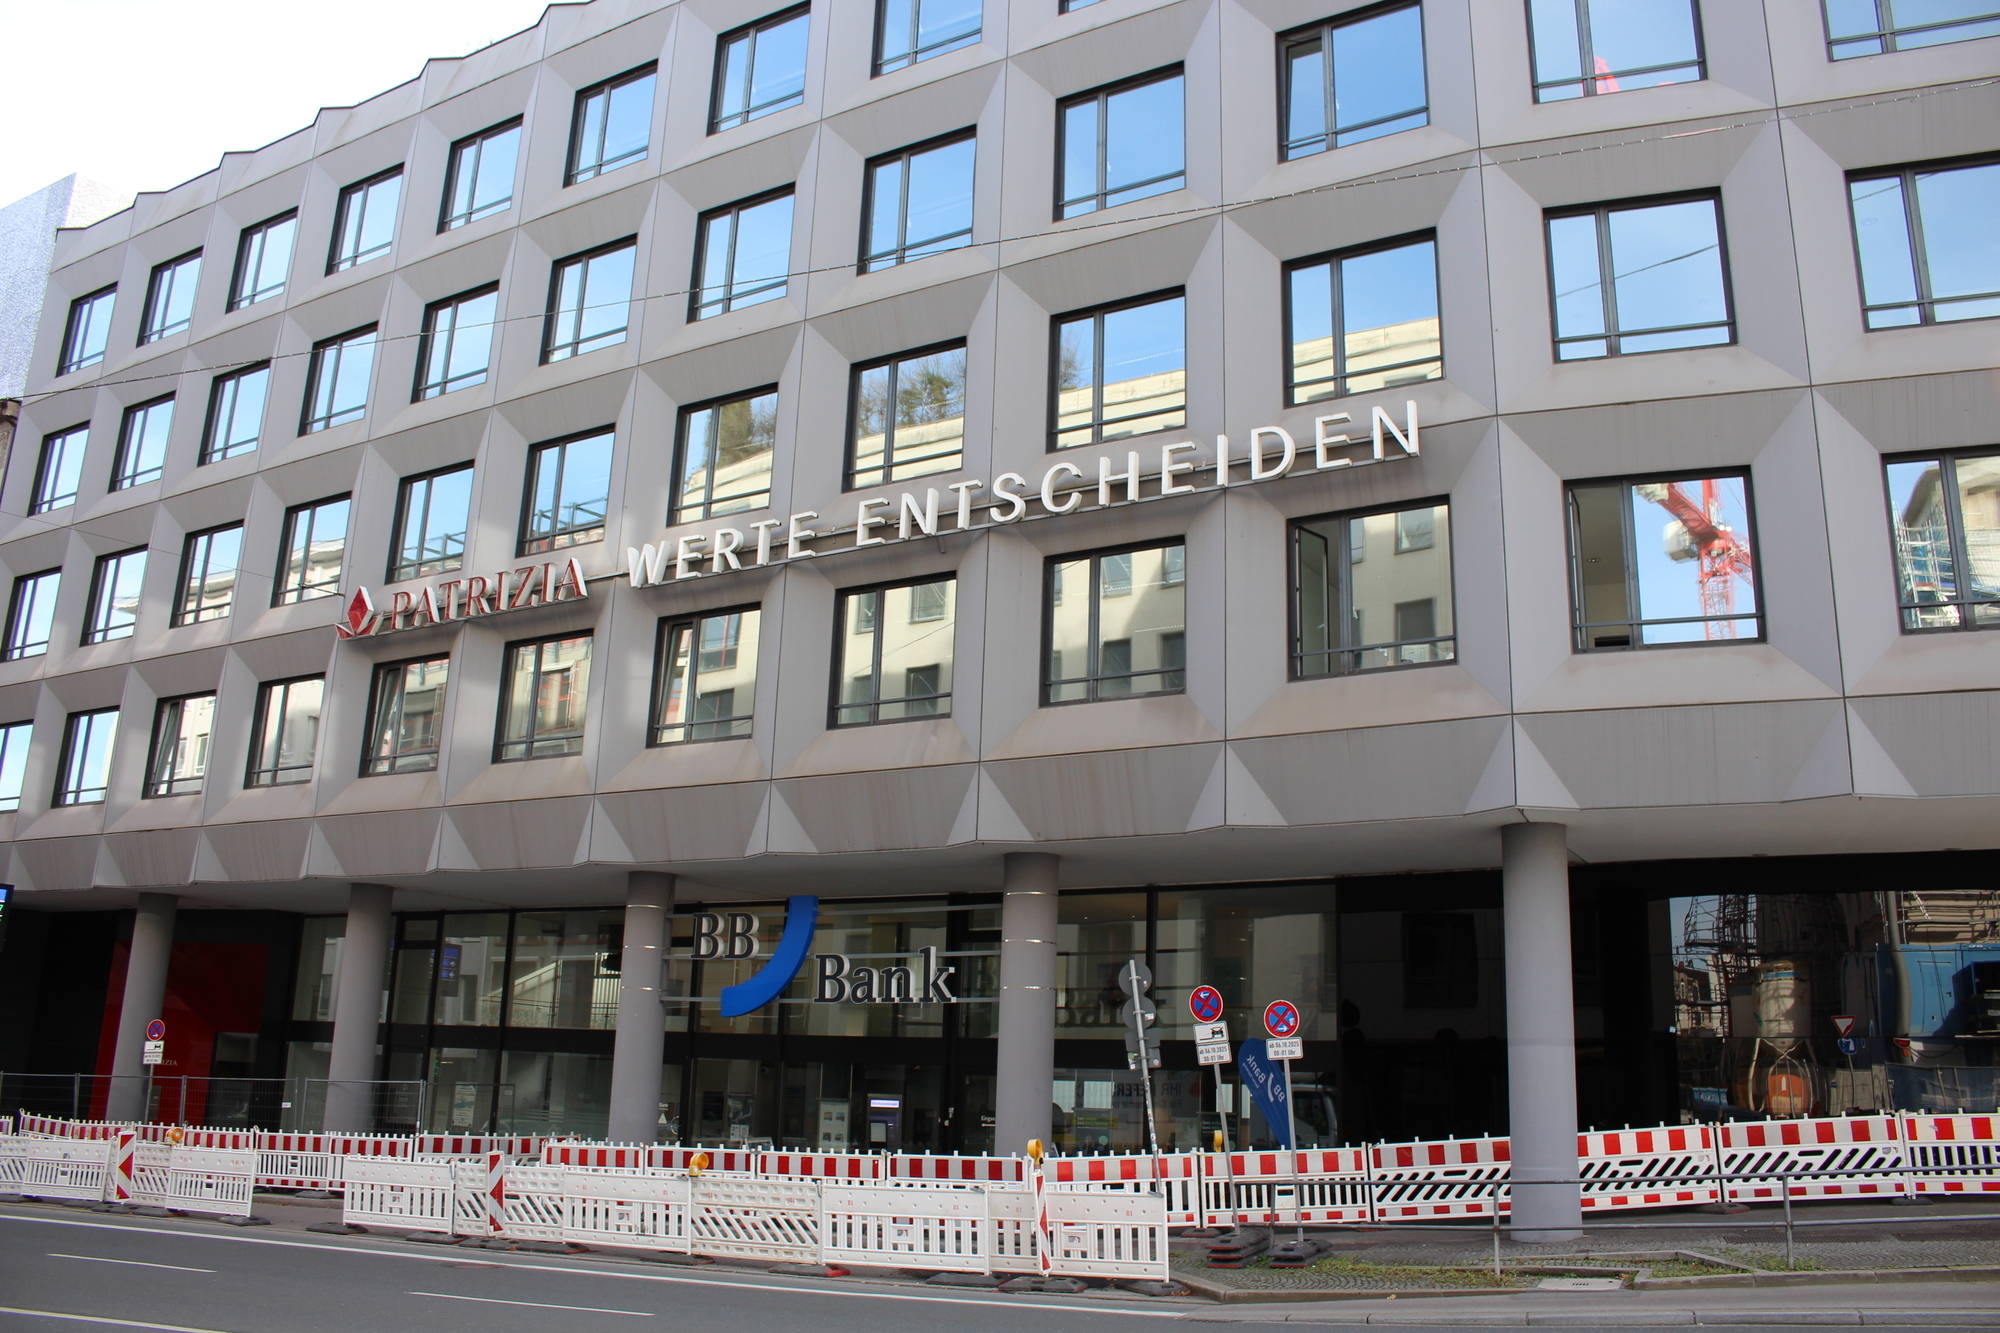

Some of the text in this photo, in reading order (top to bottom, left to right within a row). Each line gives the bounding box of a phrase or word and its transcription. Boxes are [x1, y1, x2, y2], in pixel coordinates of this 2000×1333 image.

[391, 399, 1421, 631] PATRIZIA WERTE ENTSCHEIDEN
[690, 912, 761, 960] BB
[813, 945, 957, 1004] Bank
[1275, 1041, 1299, 1049] 06.10.2025
[1287, 1048, 1296, 1056] Uhr
